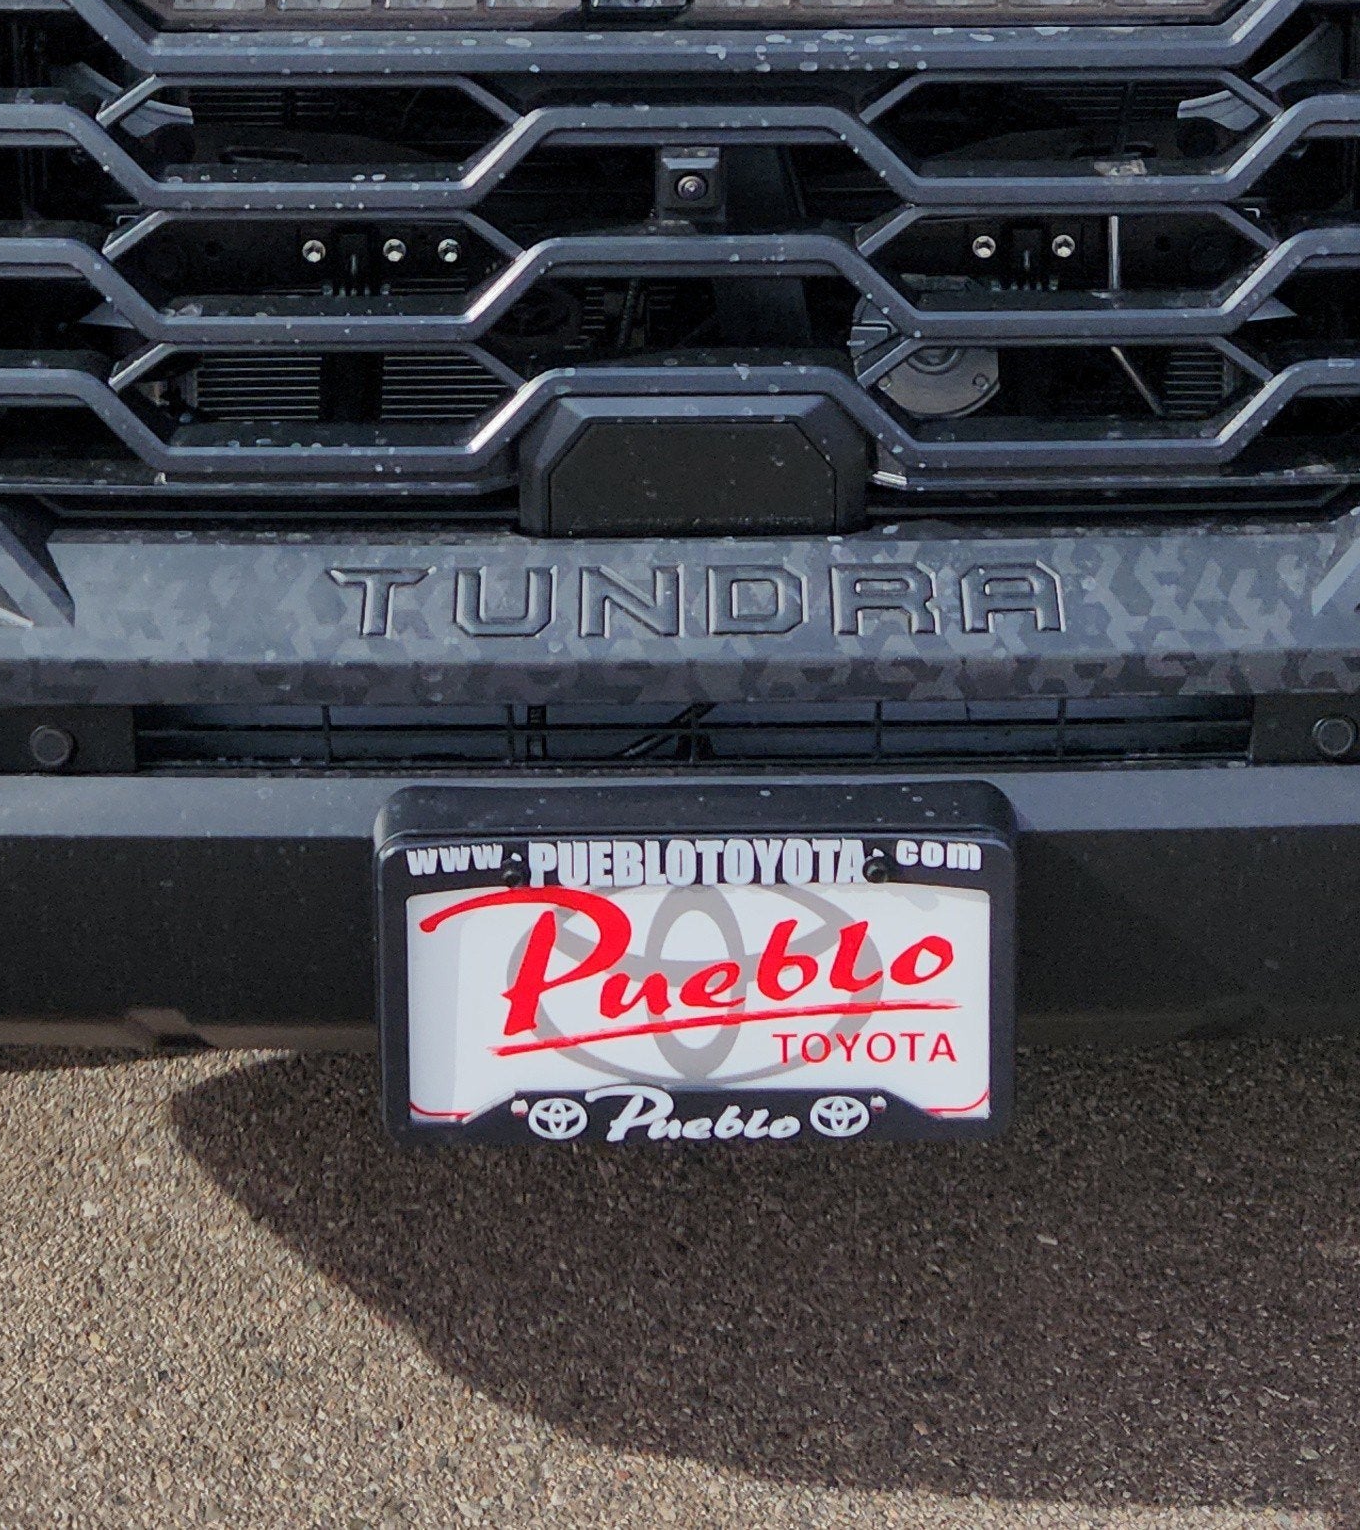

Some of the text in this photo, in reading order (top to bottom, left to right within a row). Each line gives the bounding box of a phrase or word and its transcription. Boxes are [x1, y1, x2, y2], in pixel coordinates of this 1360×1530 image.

[327, 562, 1067, 637] TUNDRA
[420, 886, 955, 1036] Pueblo
[772, 1031, 958, 1065] TOYOTA
[585, 1085, 801, 1142] Pueblo
